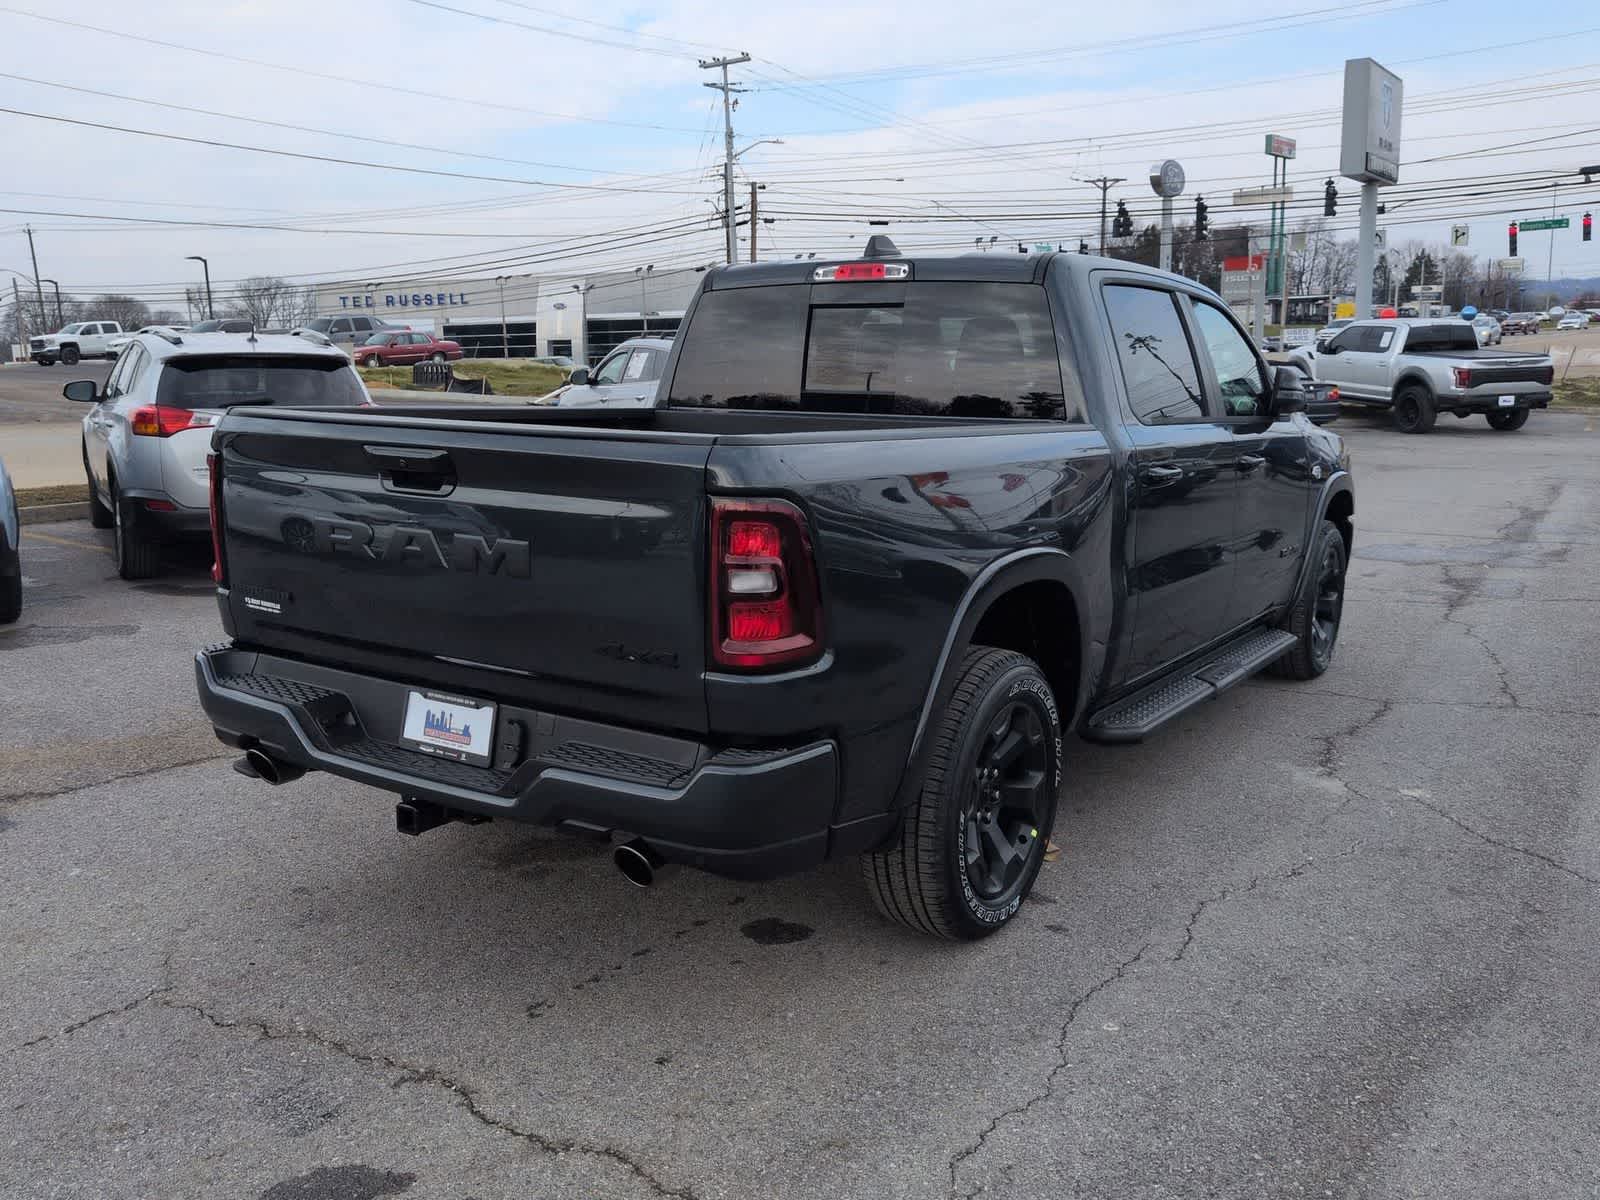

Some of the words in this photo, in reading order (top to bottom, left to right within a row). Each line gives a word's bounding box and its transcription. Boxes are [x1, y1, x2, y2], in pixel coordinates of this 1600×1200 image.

[1378, 137, 1393, 152] RAM
[338, 295, 375, 309] TED
[385, 293, 470, 307] RUSSELL
[317, 517, 532, 577] RAM
[1008, 679, 1059, 726] DUELER
[957, 810, 1021, 923] BRIDGESTONE
